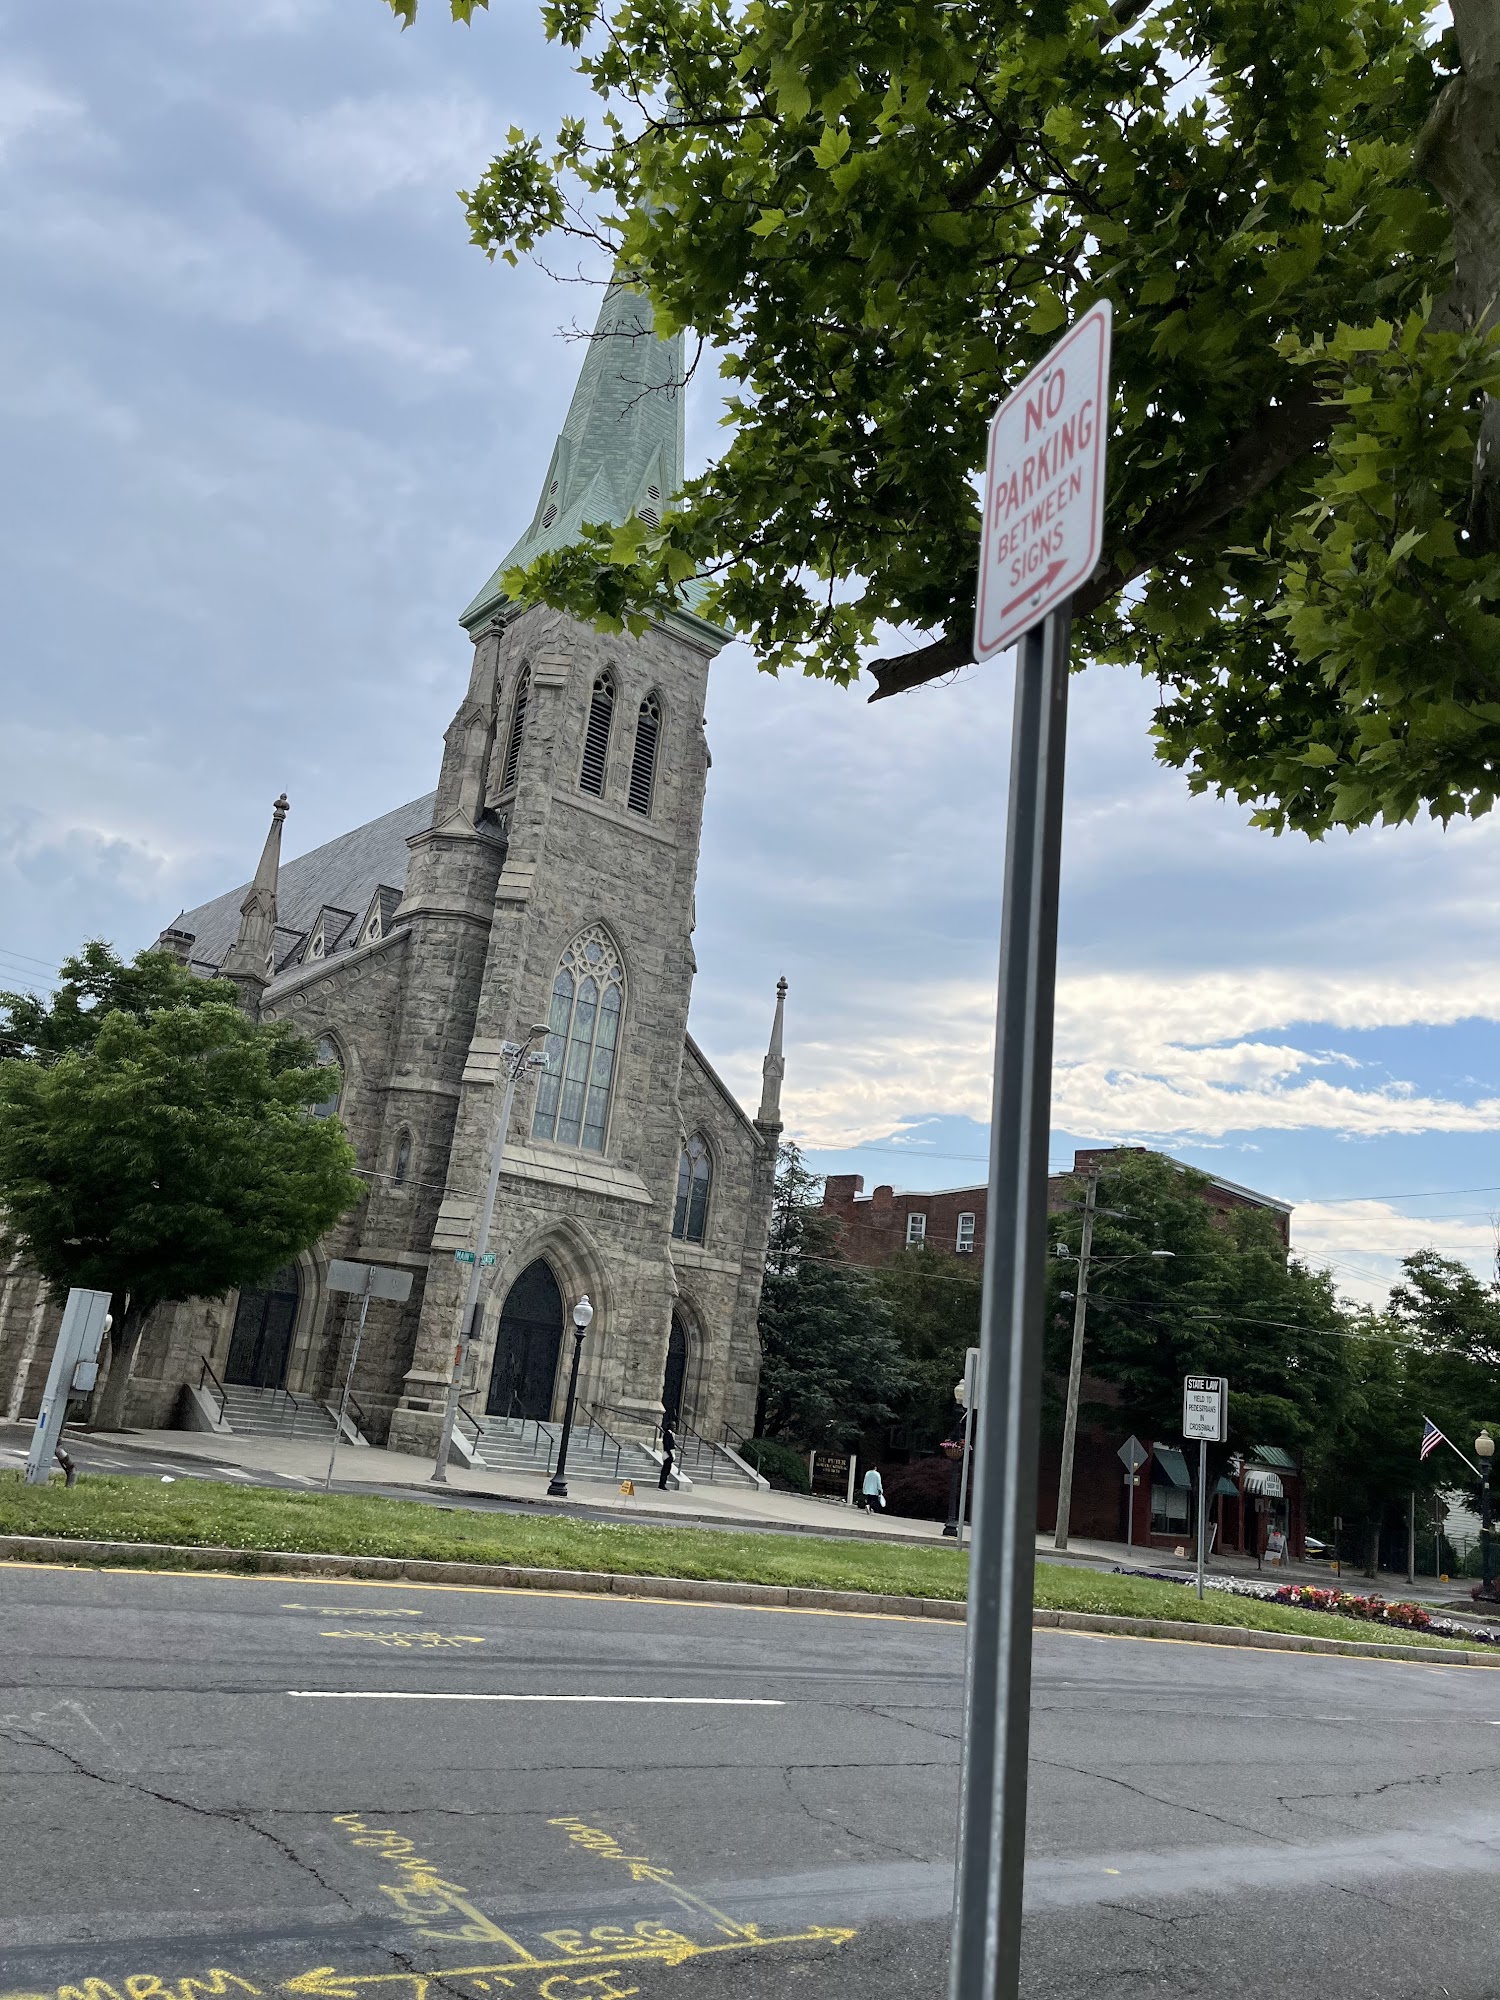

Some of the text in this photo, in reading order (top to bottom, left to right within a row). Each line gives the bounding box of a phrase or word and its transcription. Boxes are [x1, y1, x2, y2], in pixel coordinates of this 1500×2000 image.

[1023, 367, 1066, 444] NO
[995, 400, 1093, 529] PARKING
[997, 465, 1082, 565] BETWEEN
[1009, 521, 1065, 588] SIGNS
[1188, 1379, 1219, 1391] STATE LAW
[1193, 1395, 1213, 1404] YIELD TO
[1188, 1404, 1216, 1413] PEDESTRIANS
[1199, 1414, 1205, 1422] IN
[1189, 1422, 1215, 1432] CROSSWALK
